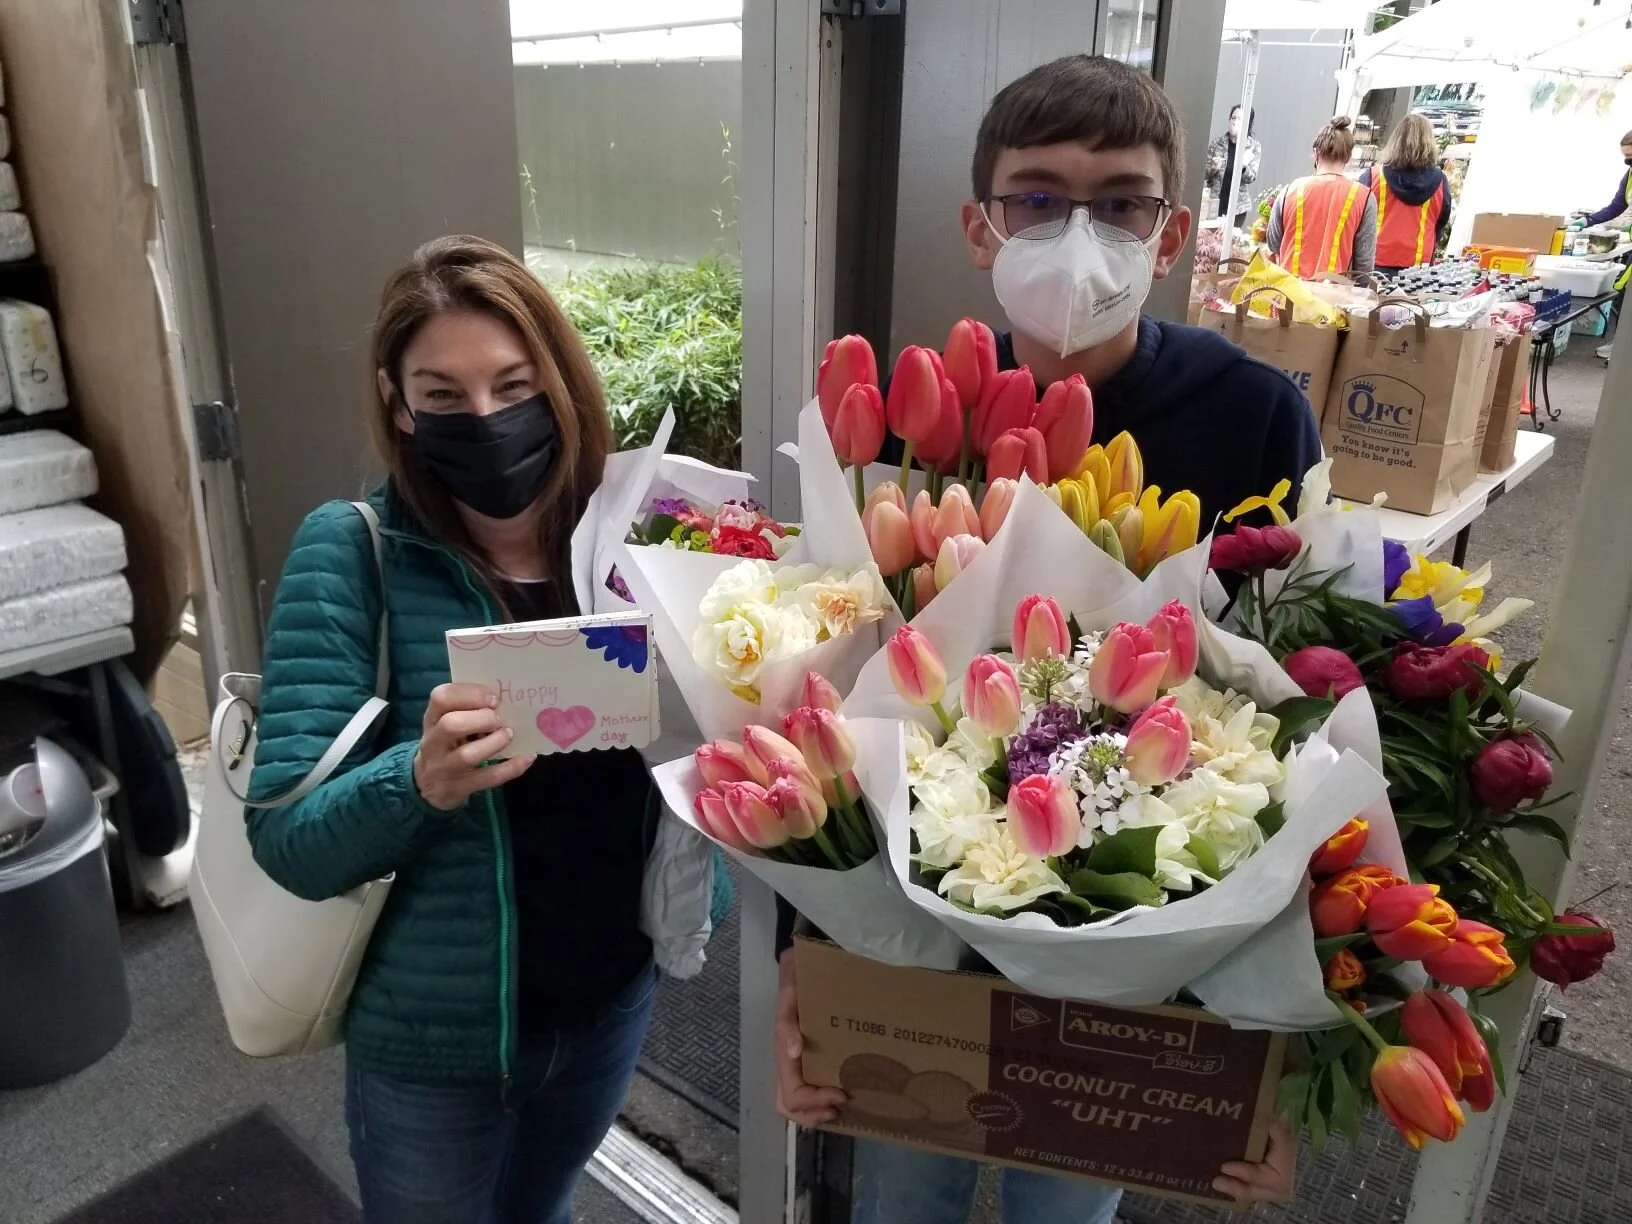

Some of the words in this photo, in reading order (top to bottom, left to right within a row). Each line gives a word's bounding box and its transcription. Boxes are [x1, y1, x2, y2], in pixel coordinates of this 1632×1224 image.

[1347, 391, 1413, 426] QFC
[1345, 421, 1367, 432] Quality
[1367, 426, 1383, 435] Food
[1384, 429, 1409, 440] Centers
[1332, 444, 1360, 458] going
[1361, 450, 1370, 460] to
[1372, 452, 1385, 462] be
[1387, 456, 1417, 469] good.
[1342, 435, 1359, 447] You
[1362, 440, 1390, 453] know
[1392, 446, 1410, 457] it's
[497, 678, 559, 706] Happy
[600, 730, 628, 744] day
[830, 1015, 840, 1028] C
[1066, 1017, 1188, 1048] AROY-D
[1003, 1063, 1136, 1101] COCONUT
[1141, 1087, 1245, 1121] CREAM
[1013, 1146, 1036, 1159] NET
[1103, 1163, 1115, 1174] 12
[1166, 1177, 1178, 1186] oz
